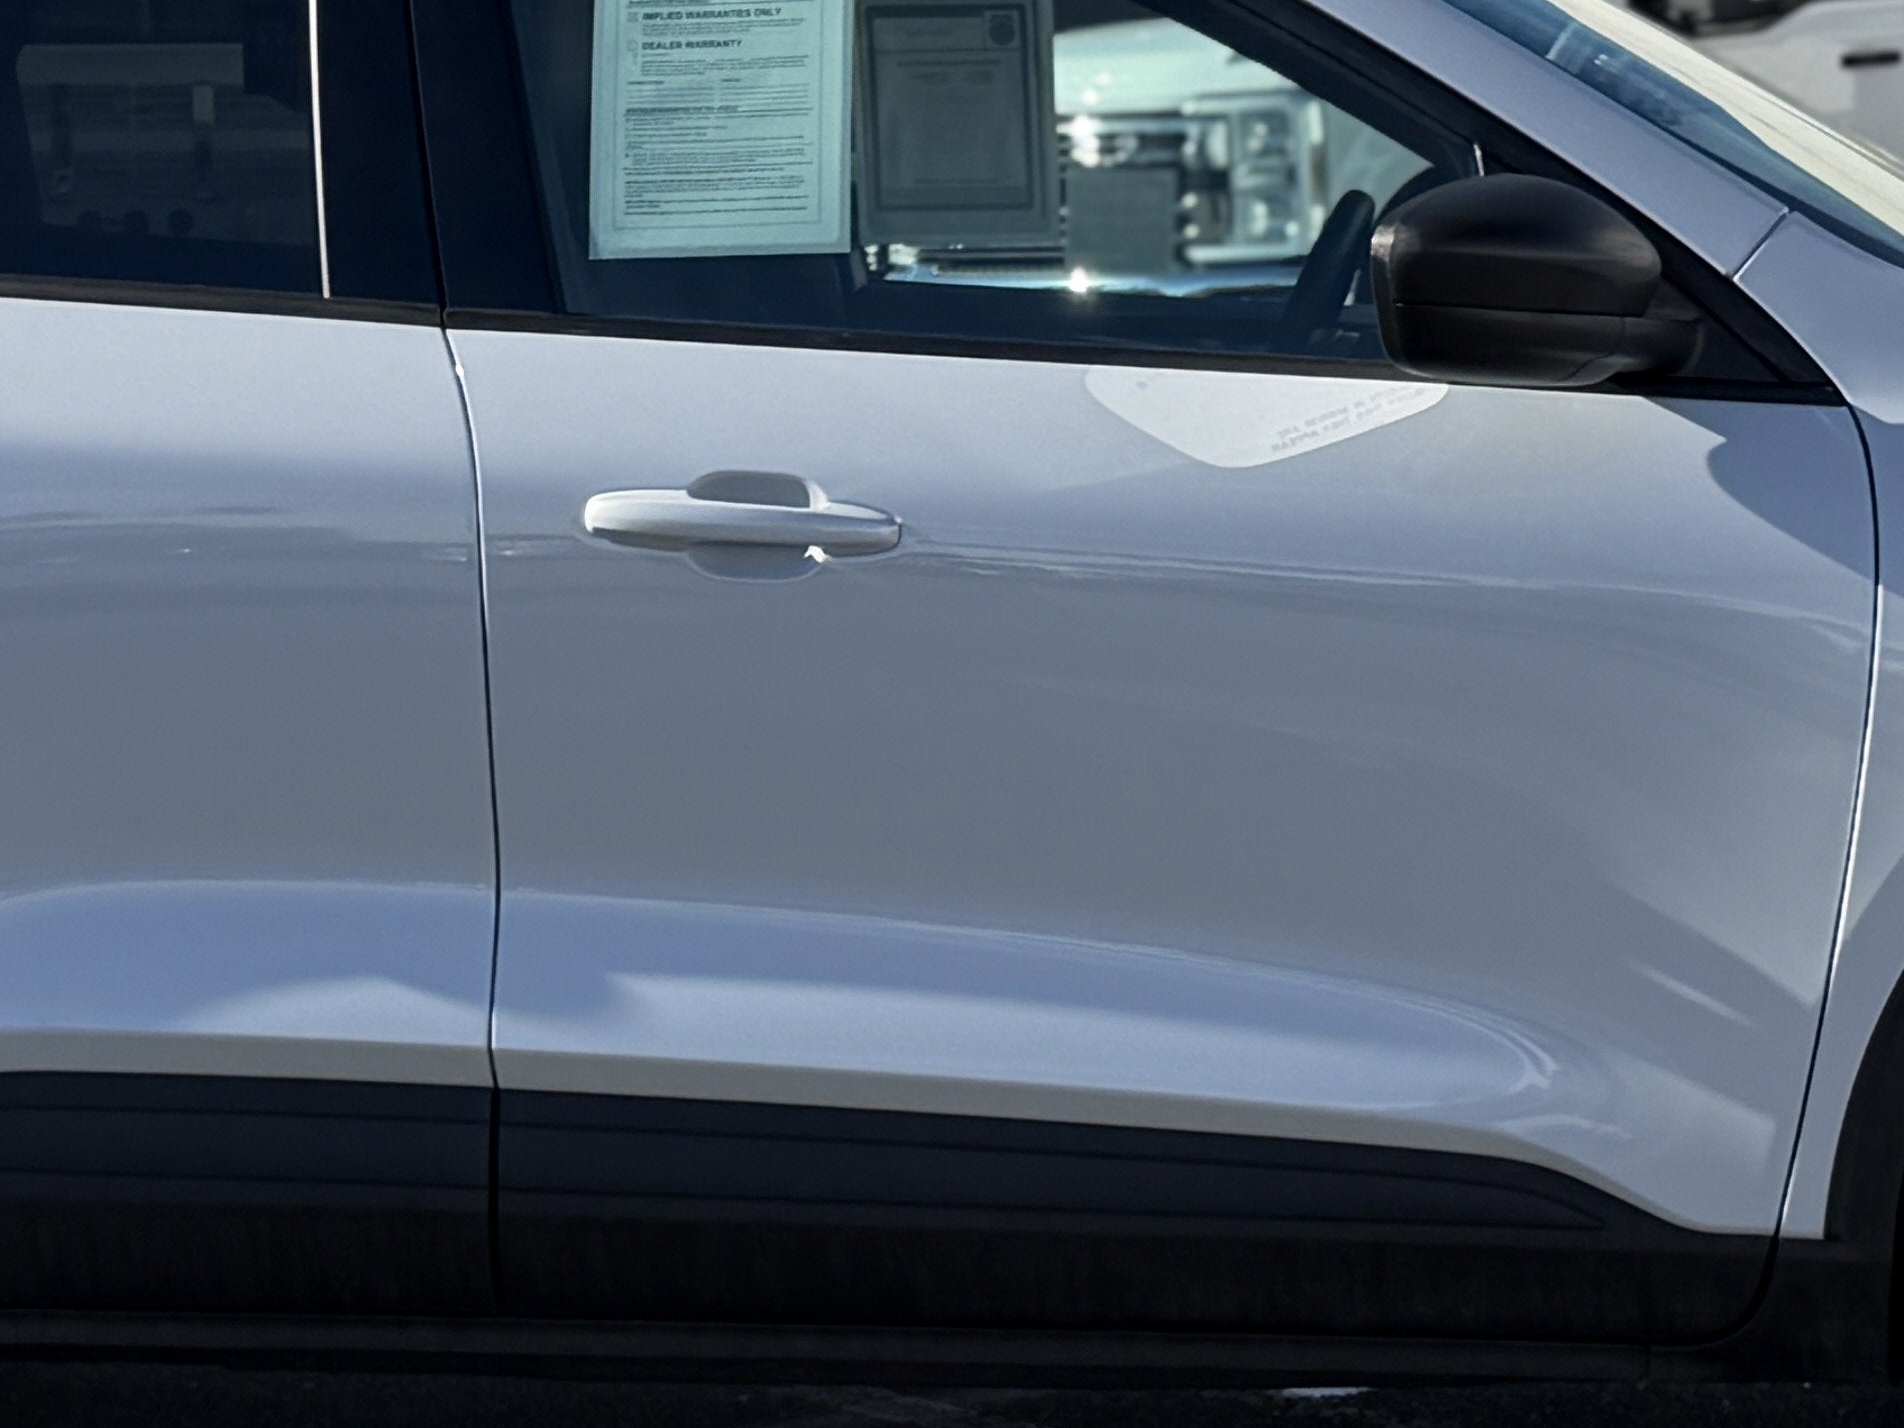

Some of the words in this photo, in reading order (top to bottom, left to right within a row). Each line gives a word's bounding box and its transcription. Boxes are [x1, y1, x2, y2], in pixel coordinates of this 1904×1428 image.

[642, 10, 683, 22] IMPLIED
[754, 6, 782, 18] ONLY
[642, 40, 683, 51] DEALER
